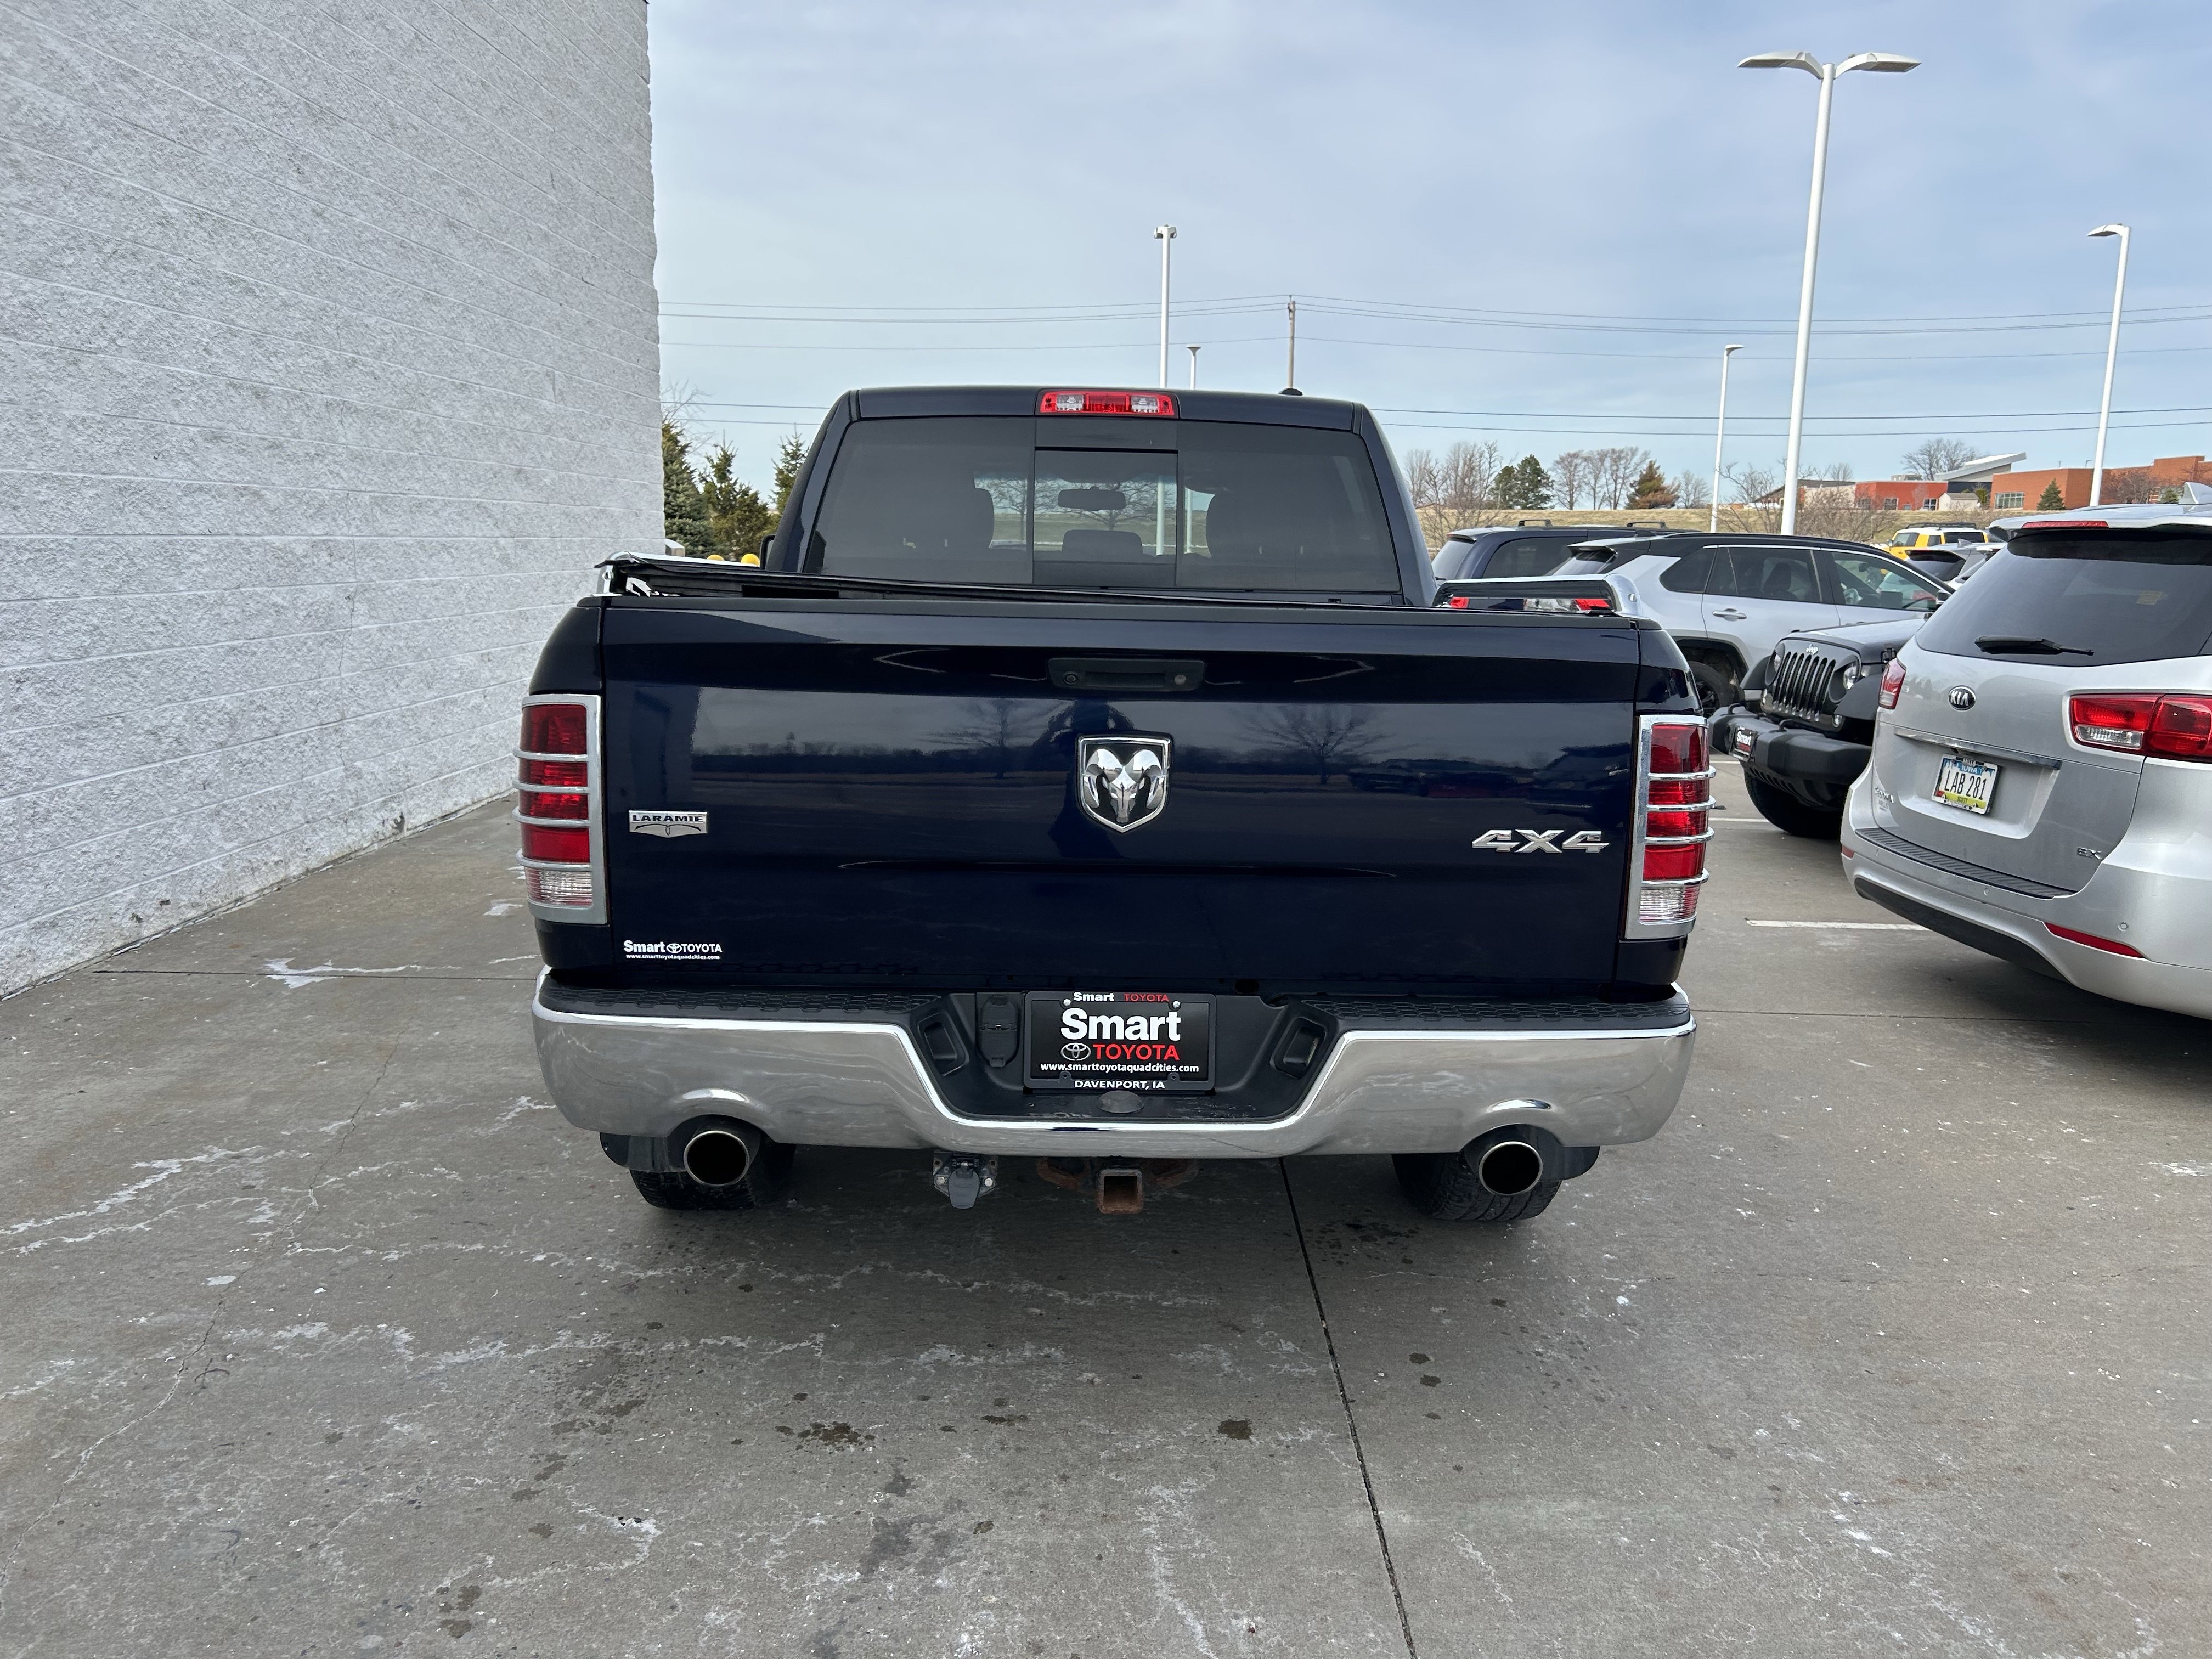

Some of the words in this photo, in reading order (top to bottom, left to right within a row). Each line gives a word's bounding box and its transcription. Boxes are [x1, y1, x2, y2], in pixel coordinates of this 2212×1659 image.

[1950, 691, 1969, 706] KIA
[1737, 731, 1752, 746] Smart
[1944, 770, 1966, 794] LAB
[1966, 776, 1986, 800] 281
[2077, 847, 2102, 860] EX
[624, 940, 665, 952] Smart
[681, 944, 722, 952] TOYOTA
[1073, 992, 1115, 1002] Smart
[1124, 994, 1170, 1002] TOYOTA
[1060, 1007, 1181, 1041] Smart
[1093, 1044, 1180, 1060] TOYOTA
[1040, 1063, 1199, 1073] www.smarttoyotaquadcities.com
[1074, 1080, 1149, 1090] DAVENPORT,
[1153, 1080, 1165, 1089] IA
